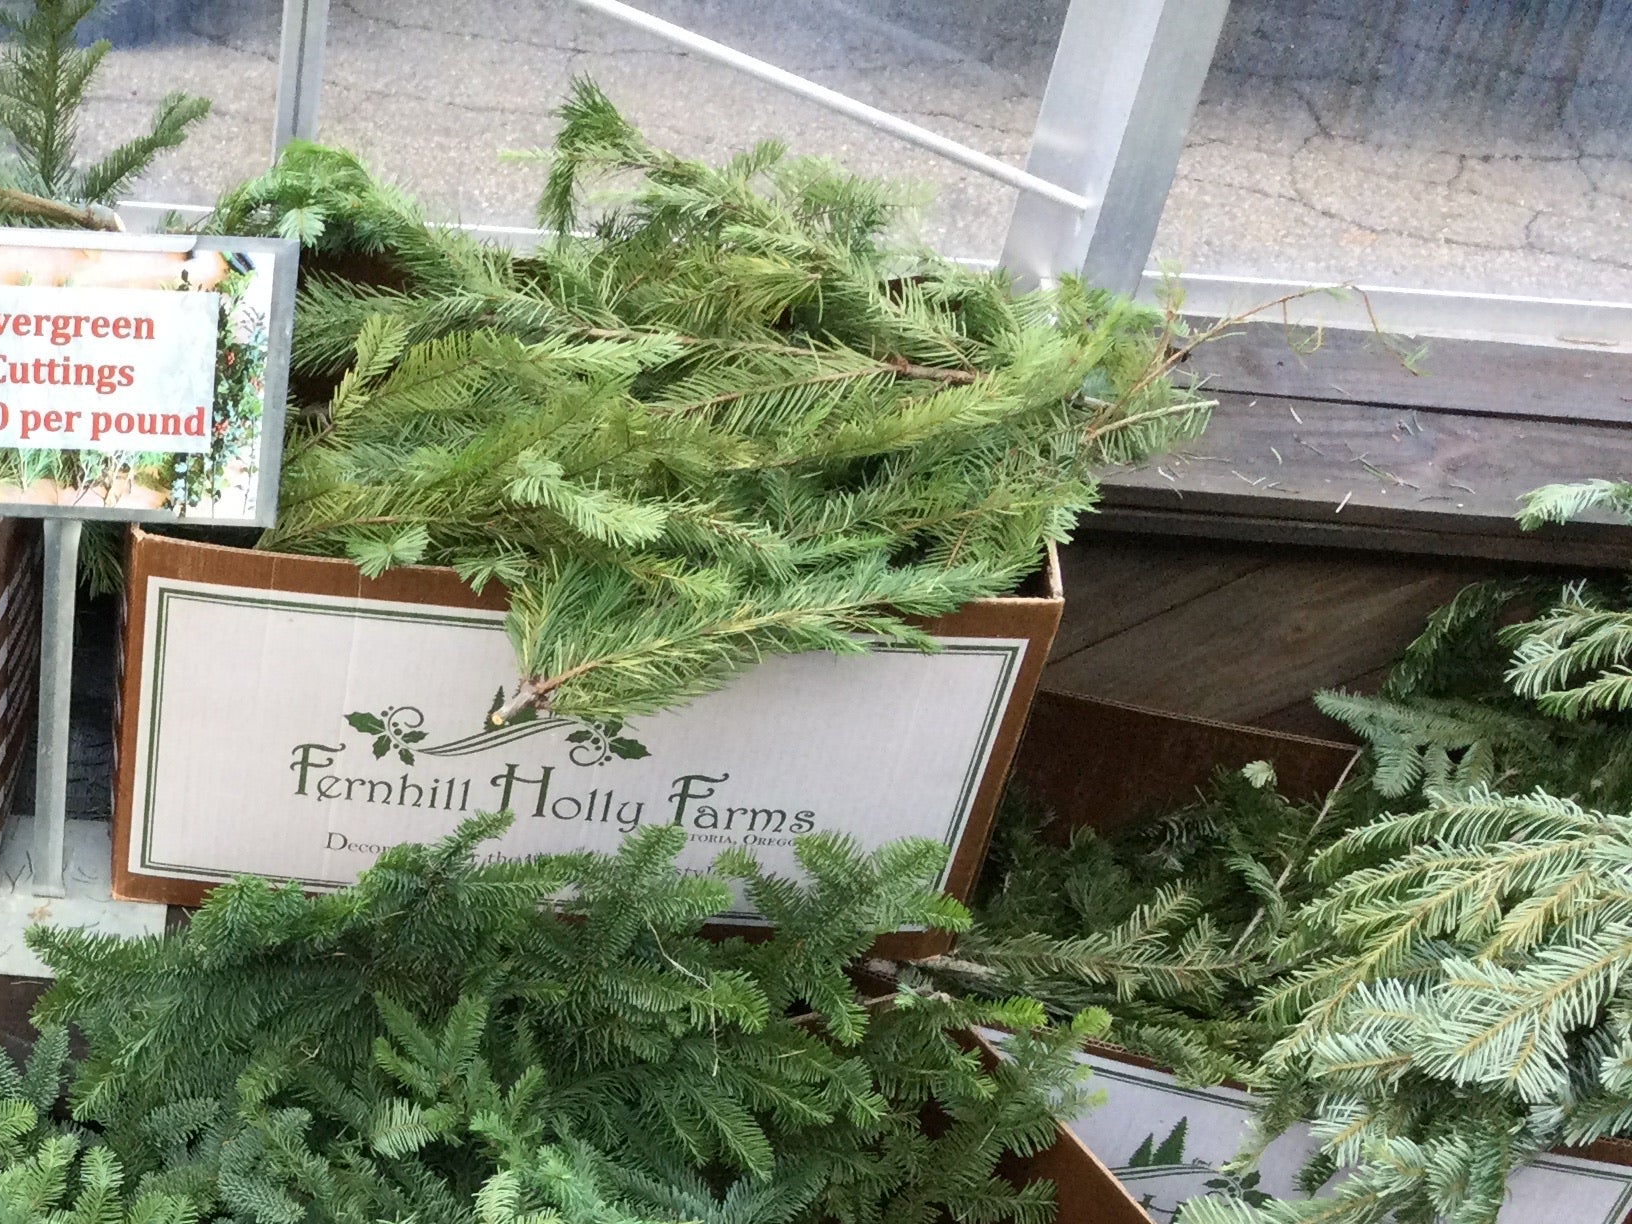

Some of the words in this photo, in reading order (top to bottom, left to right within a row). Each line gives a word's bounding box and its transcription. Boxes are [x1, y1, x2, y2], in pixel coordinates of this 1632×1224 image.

[20, 408, 82, 439] per
[90, 406, 206, 441] pound
[290, 742, 470, 811] Fernhill
[490, 763, 645, 833] Holly
[669, 773, 815, 833] Farms
[689, 833, 737, 846] TORIA,
